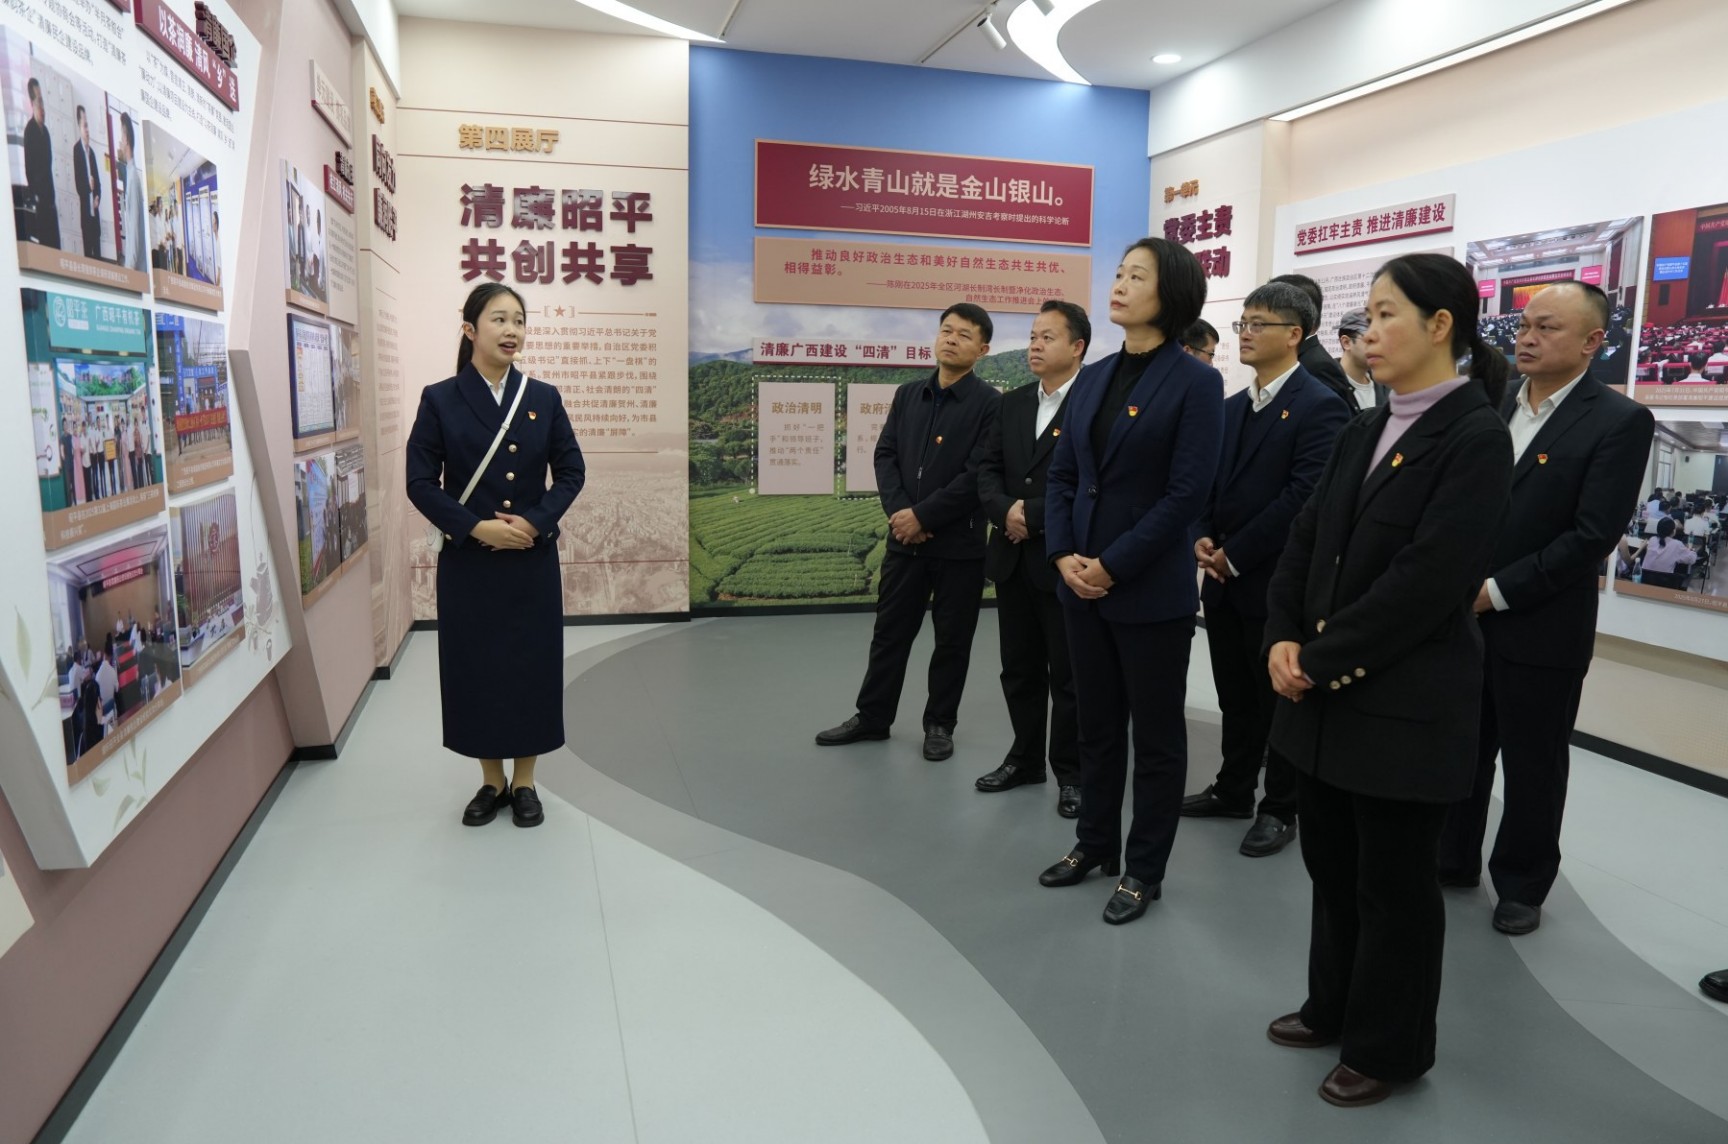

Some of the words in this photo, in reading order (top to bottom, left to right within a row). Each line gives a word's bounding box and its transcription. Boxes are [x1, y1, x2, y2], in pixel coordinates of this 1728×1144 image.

[458, 123, 559, 154] 第四展厅
[809, 163, 1064, 206] 绿水青山就是金山银山。
[460, 183, 653, 234] 清廉昭平
[1163, 205, 1232, 245] 党委主责
[1297, 218, 1363, 247] 党委扛牢主责
[1366, 202, 1446, 235] 推进清廉建设
[460, 237, 653, 286] 共创共享
[784, 261, 843, 277] 相得益彰。
[811, 248, 1067, 274] 推动良好政治生态和美好自然生态共生共优、
[965, 294, 1065, 305] 自然生态工作推进会上
[760, 342, 932, 361] 清廉广西建设“四清”目标
[771, 401, 823, 415] 政治清明
